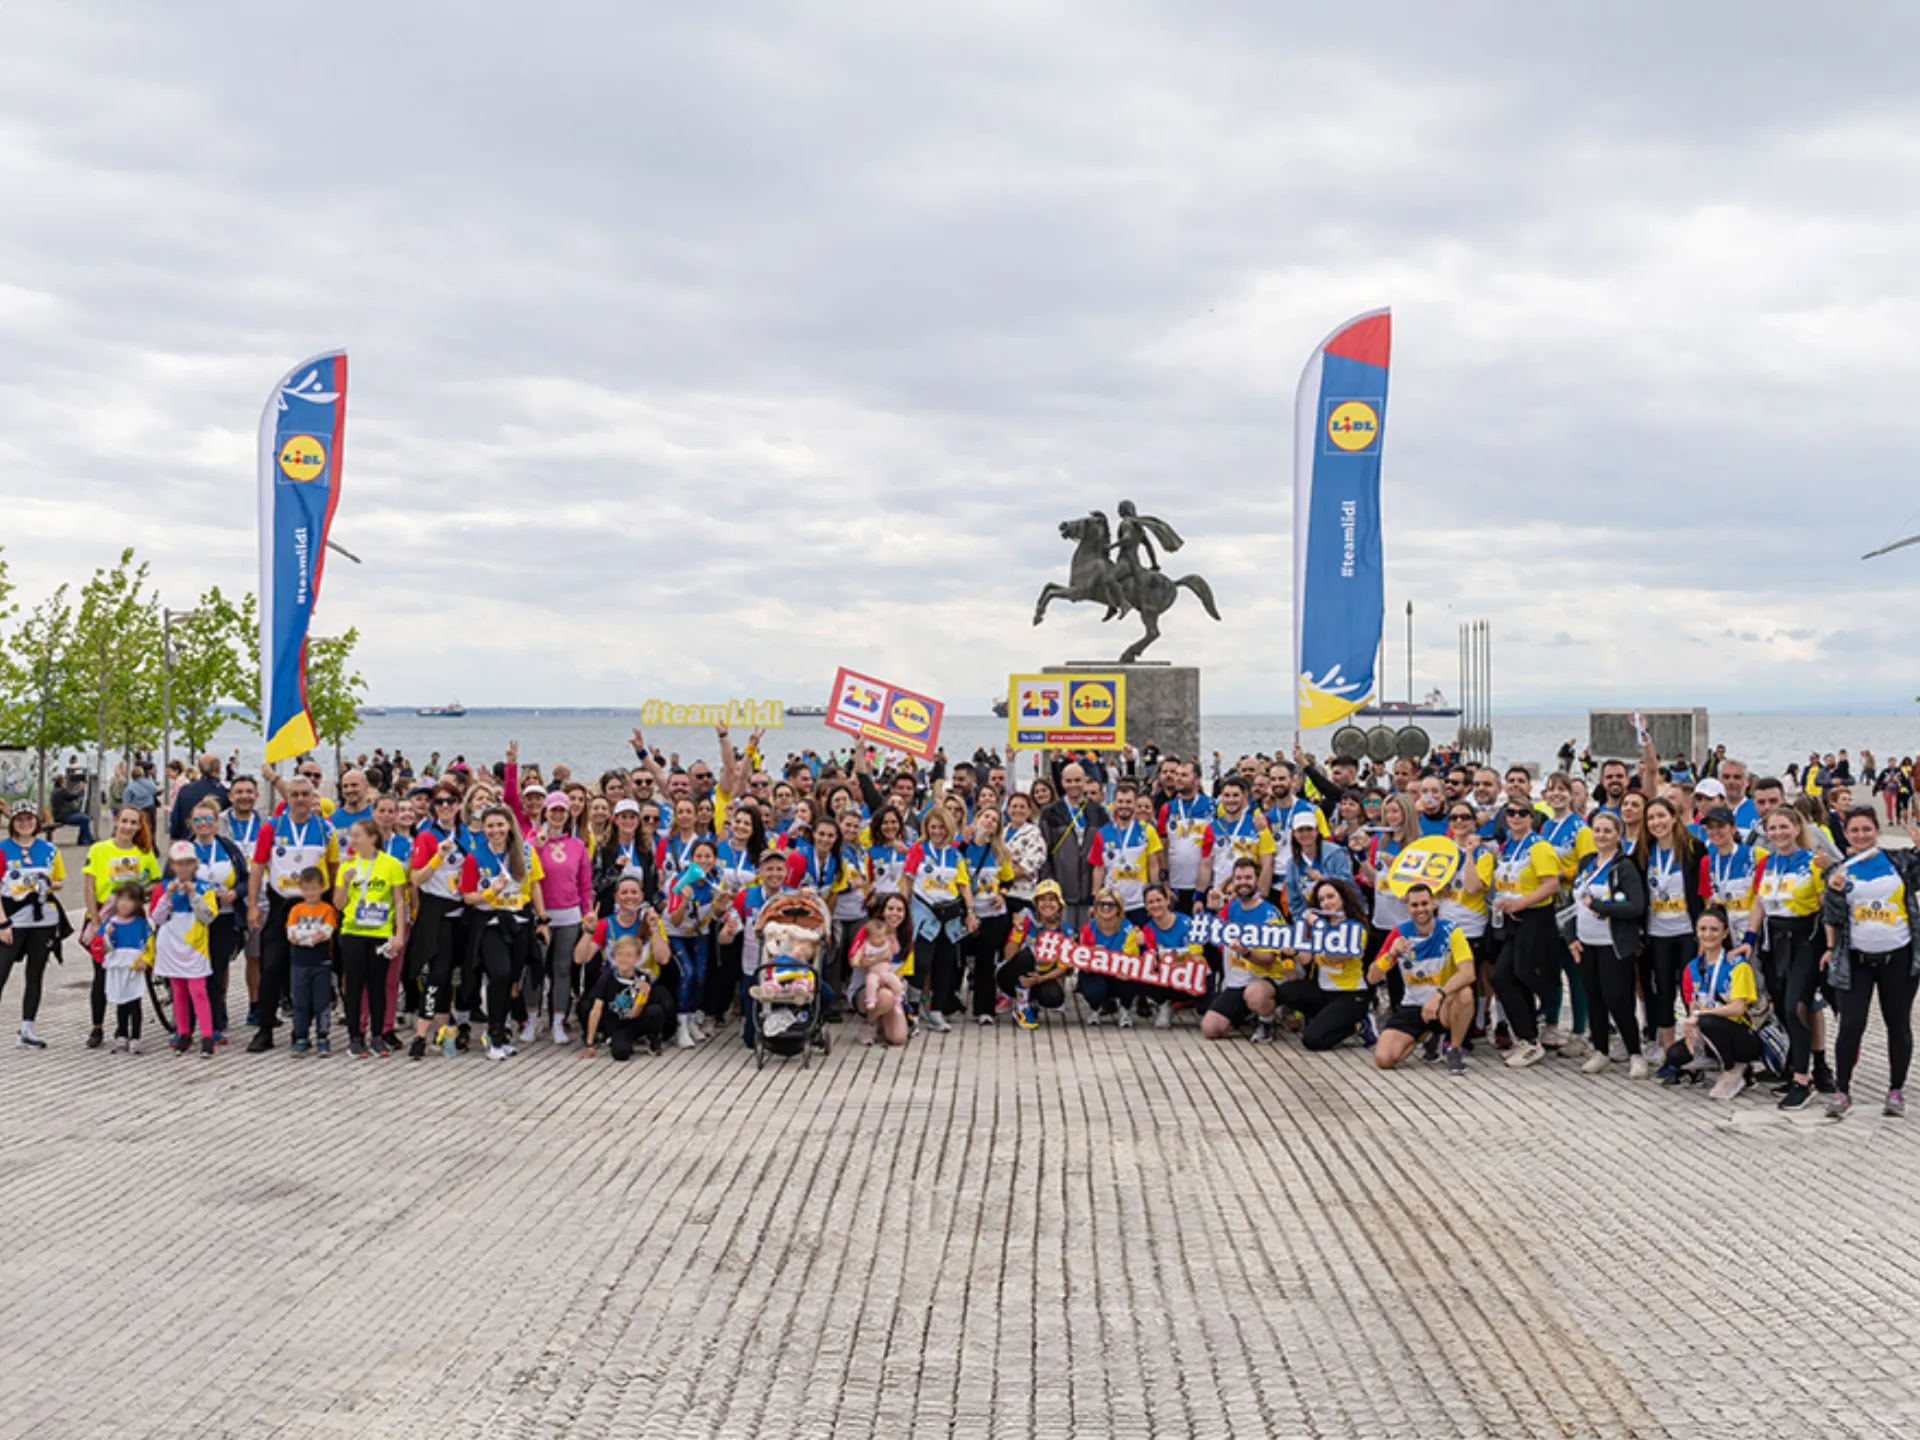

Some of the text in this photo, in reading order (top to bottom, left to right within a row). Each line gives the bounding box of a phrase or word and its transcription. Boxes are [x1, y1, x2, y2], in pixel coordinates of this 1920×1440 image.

[642, 698, 783, 727] #teamLidl
[1022, 689, 1060, 717] 25
[1188, 914, 1362, 954] #teamLidl
[1036, 930, 1207, 992] #teamLidl
